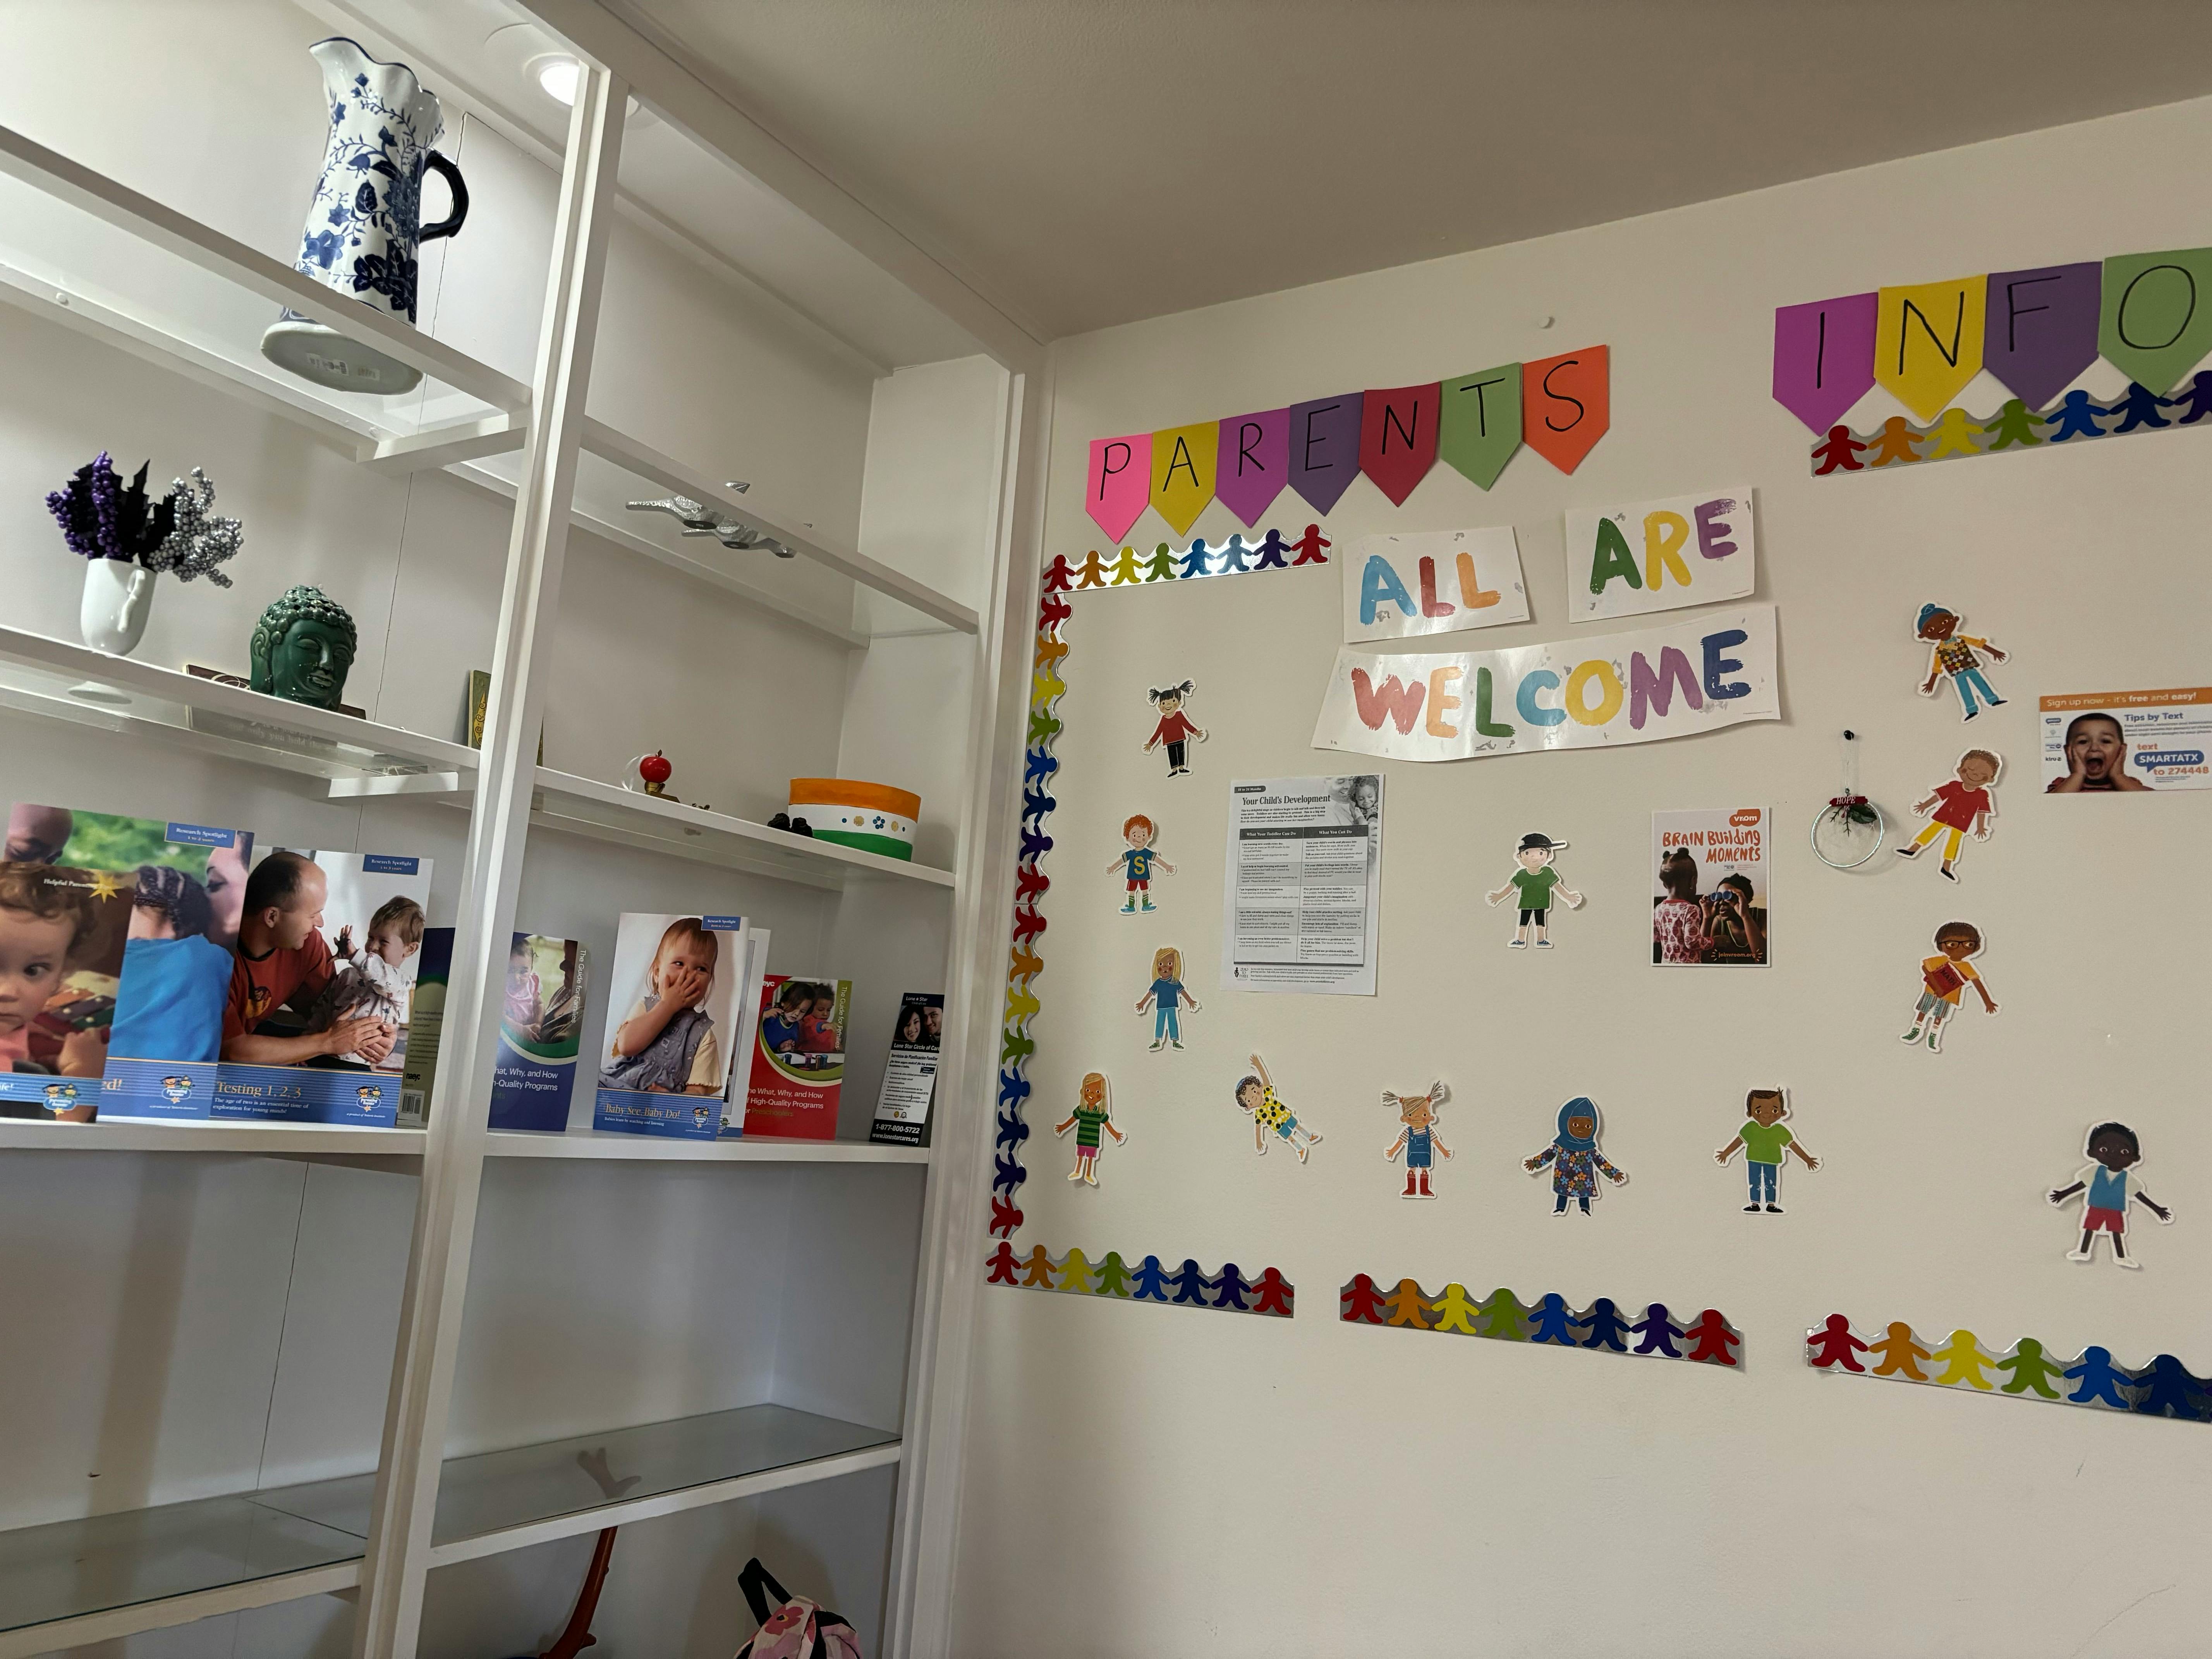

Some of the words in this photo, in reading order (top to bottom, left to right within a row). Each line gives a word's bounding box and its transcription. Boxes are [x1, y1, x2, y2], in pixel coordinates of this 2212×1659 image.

[1817, 265, 2196, 389] INFO
[1099, 360, 1585, 501] PARENTS
[1360, 552, 1501, 625] ALL
[1589, 498, 1738, 595] ARE
[1351, 629, 1752, 738] WELCOME
[2047, 699, 2066, 708] Sign
[2171, 692, 2197, 701] easy!
[2140, 754, 2198, 763] SMARTATX
[2168, 766, 2209, 775] 274448
[1242, 797, 1258, 805] Your
[1260, 796, 1282, 804] Child's
[1284, 795, 1331, 804] Development
[1836, 796, 1855, 805] HOPE
[1662, 831, 1704, 847] BRAIN
[1134, 856, 1145, 874] S
[571, 996, 580, 1024] Families
[835, 1025, 843, 1049] Families
[406, 1073, 421, 1081] naeyc
[510, 1068, 526, 1077] Why,
[217, 1081, 262, 1097] Testing
[293, 1087, 301, 1099] 3
[525, 1082, 558, 1091] Programs
[750, 1097, 791, 1108] High-Quality
[792, 1101, 824, 1109] Programs
[605, 1103, 623, 1116] Baby
[644, 1107, 663, 1120] Baby
[665, 1109, 680, 1119] Do!
[872, 1133, 919, 1144] www.lonestarcares.org
